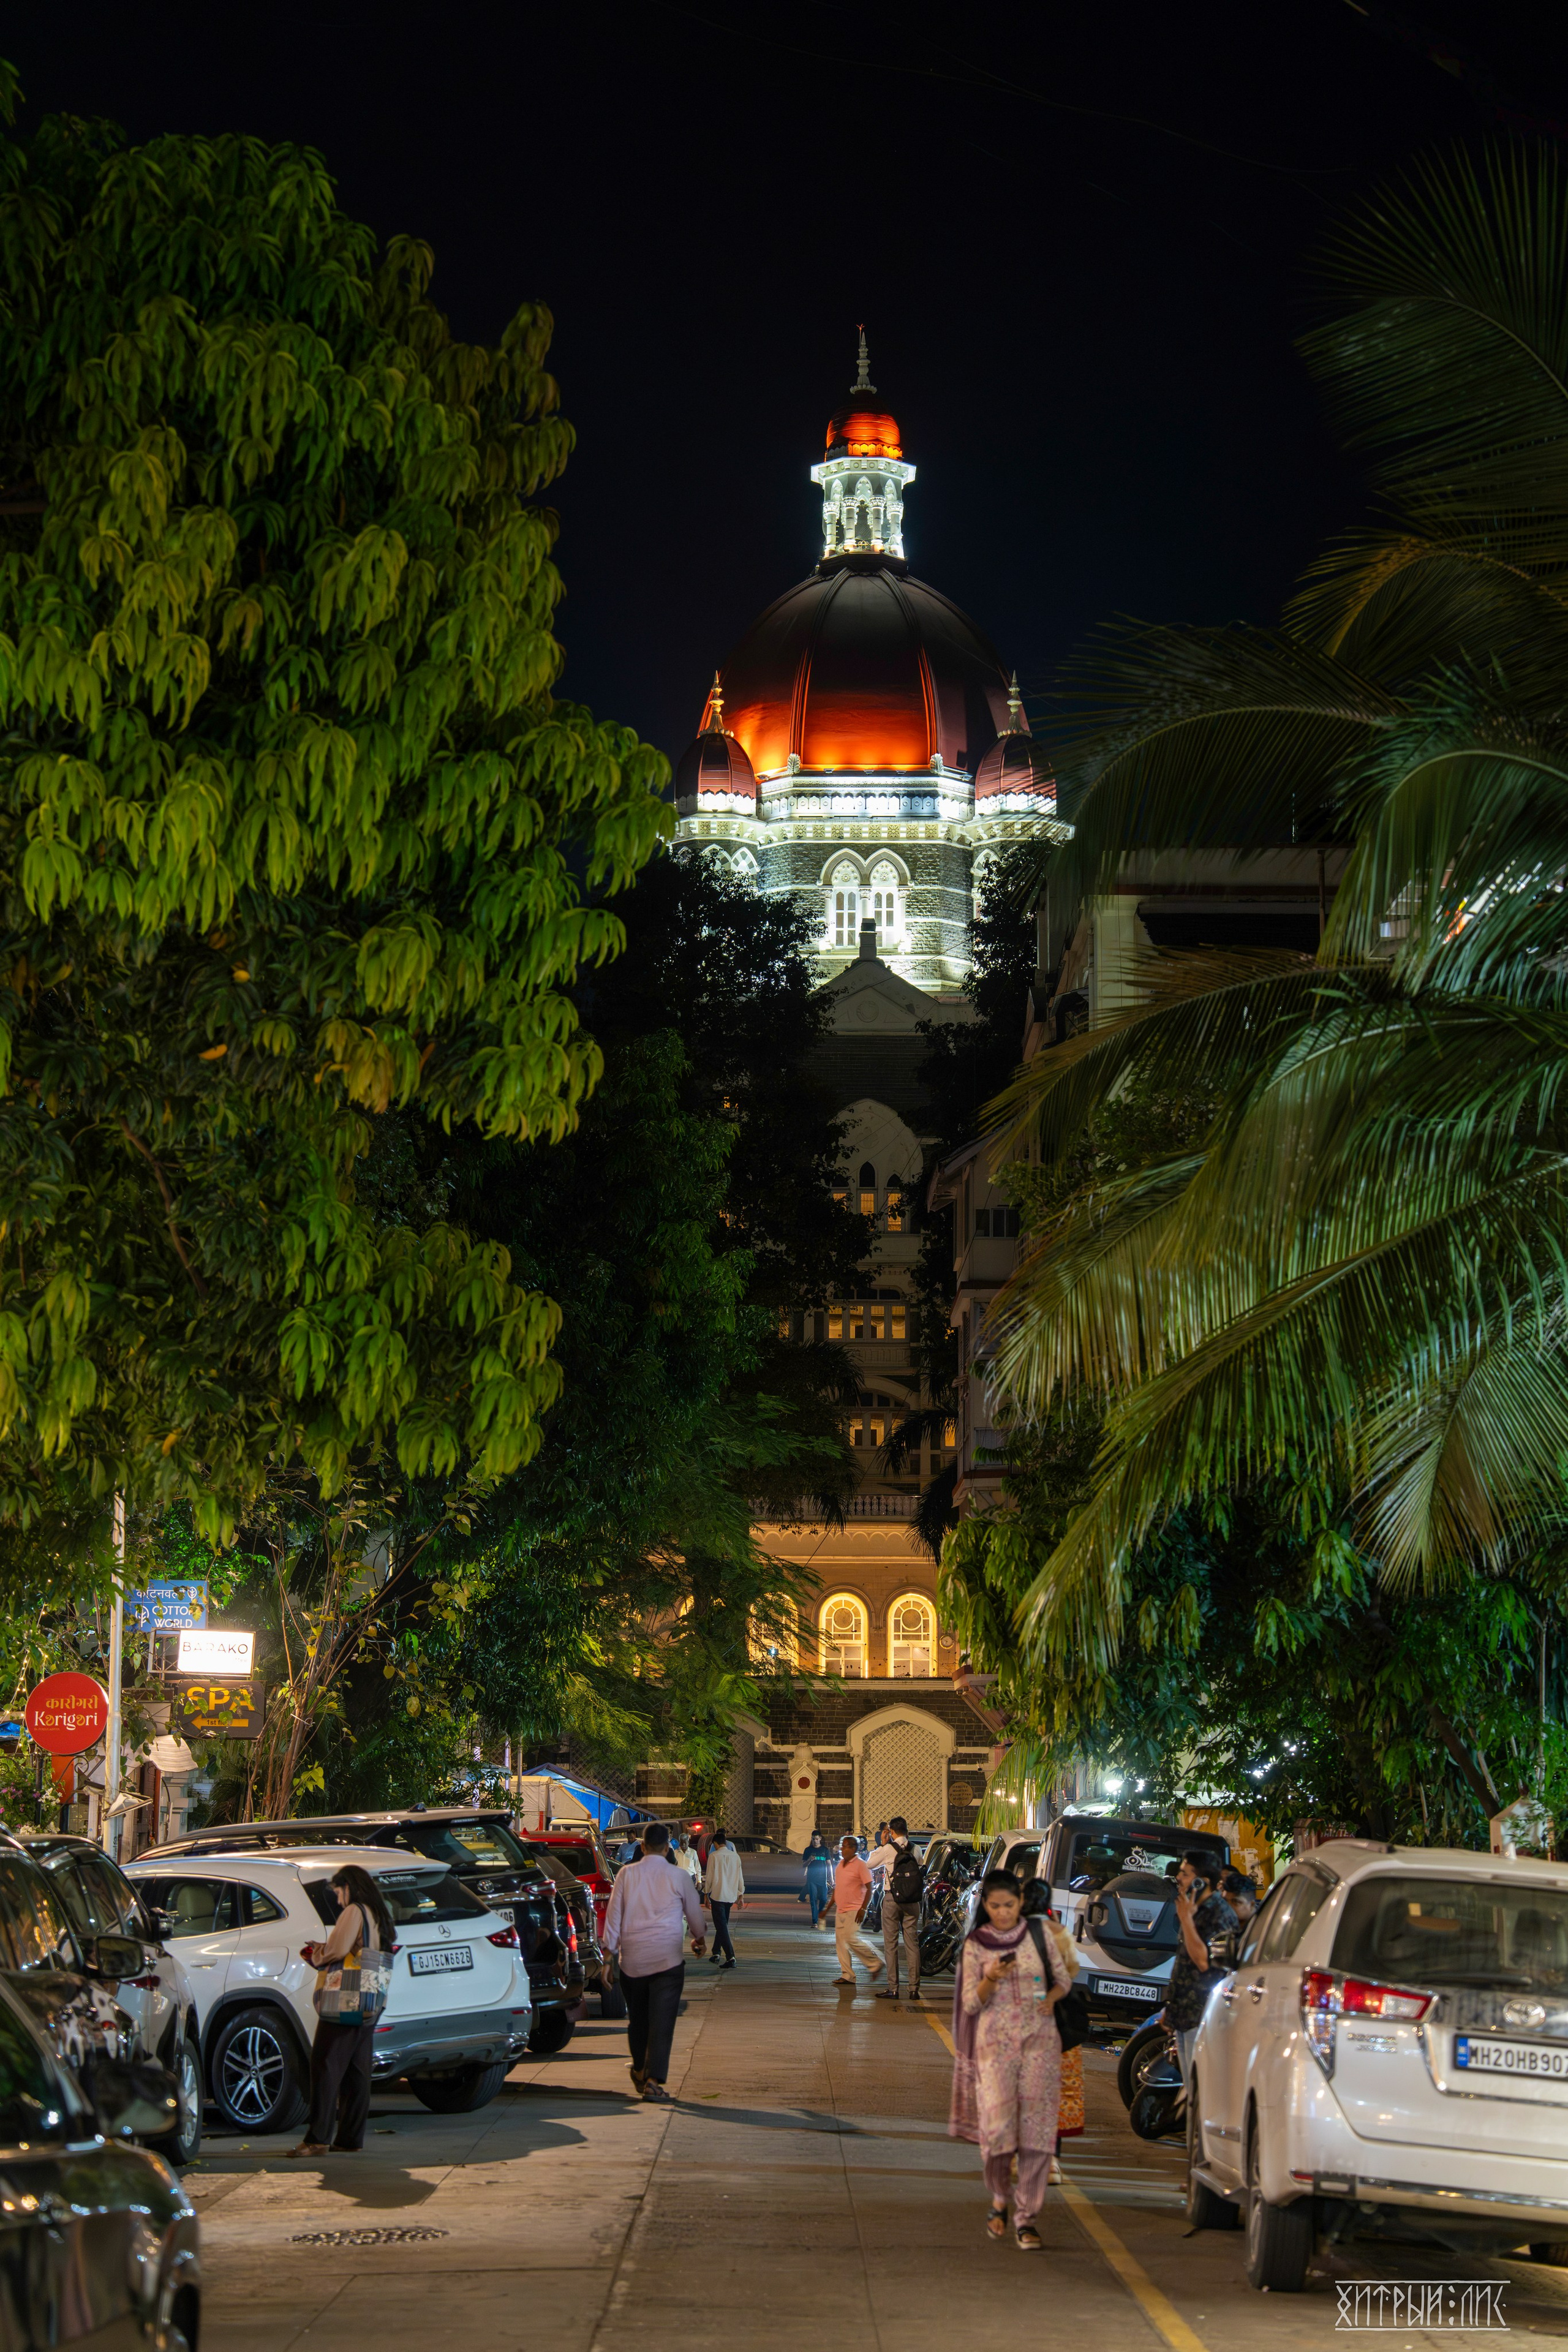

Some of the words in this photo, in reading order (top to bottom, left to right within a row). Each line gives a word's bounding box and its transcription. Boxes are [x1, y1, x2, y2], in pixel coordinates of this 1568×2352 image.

[154, 1618, 193, 1629] WORLD
[46, 1695, 98, 1709] कारीगरी
[34, 1711, 98, 1730] Karigari
[418, 1951, 470, 1969] GJ15CN6626
[1103, 1983, 1156, 1999] MH22BC8448
